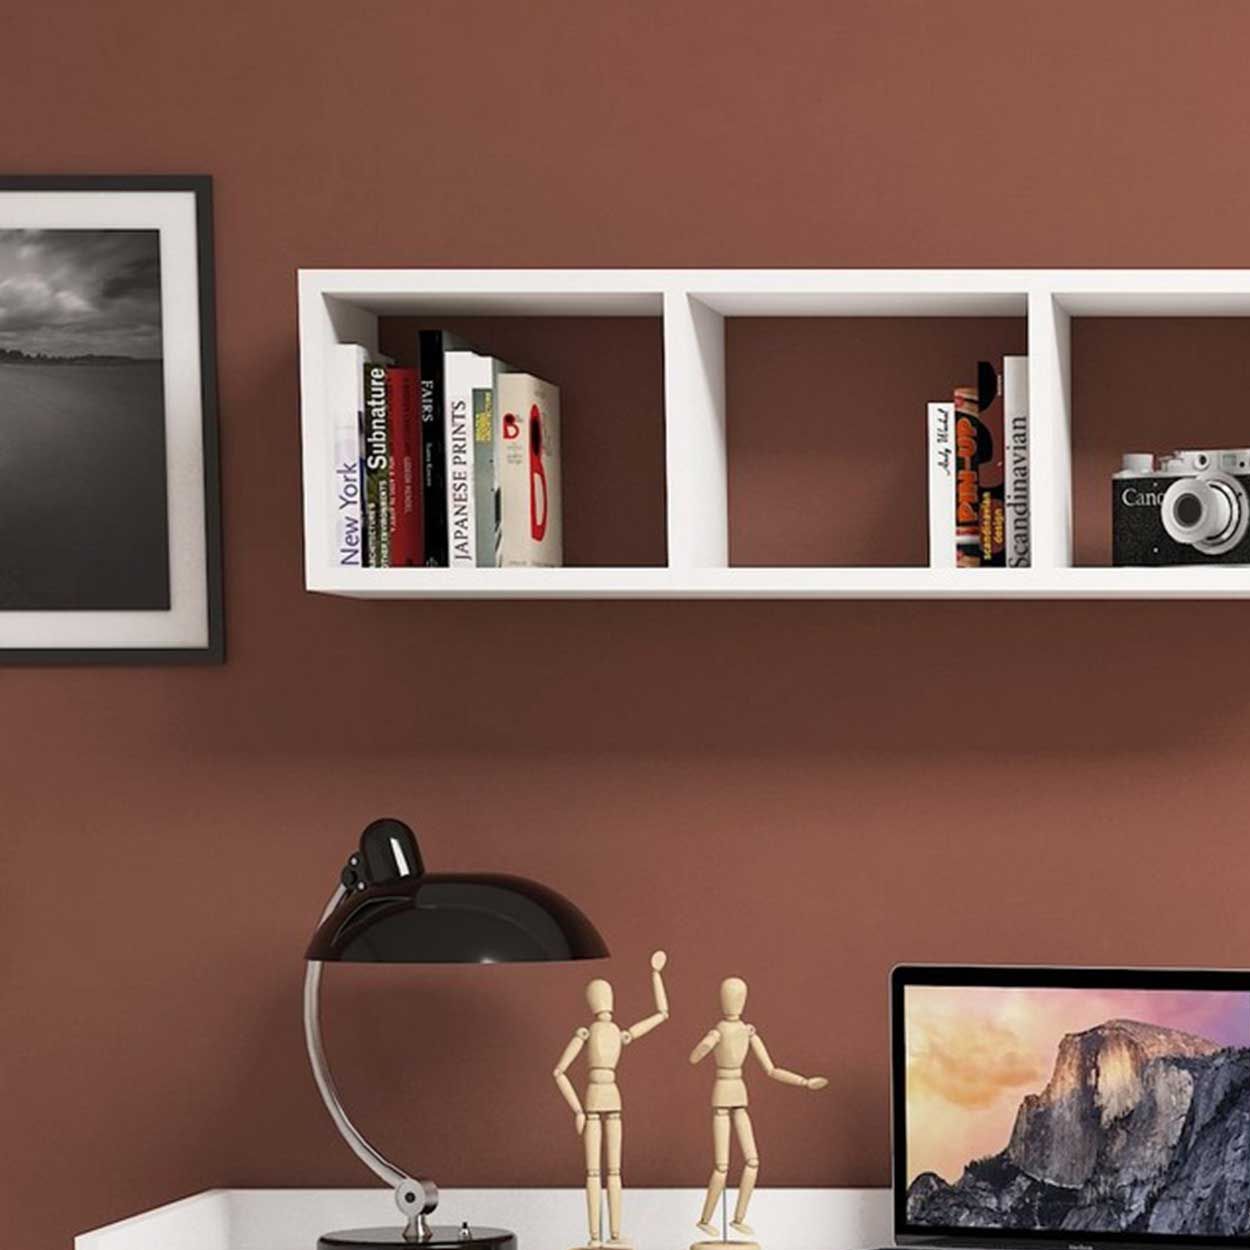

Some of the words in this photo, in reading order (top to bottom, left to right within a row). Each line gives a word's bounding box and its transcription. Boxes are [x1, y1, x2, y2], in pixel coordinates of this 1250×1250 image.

[367, 368, 388, 470] Subnature
[451, 400, 466, 465] PRINTS
[337, 462, 358, 509] York
[957, 417, 978, 523] PIN-UP
[1007, 416, 1029, 568] Scandinavian
[1122, 488, 1164, 507] Cano
[340, 516, 360, 565] New
[453, 472, 472, 560] JAPANESE
